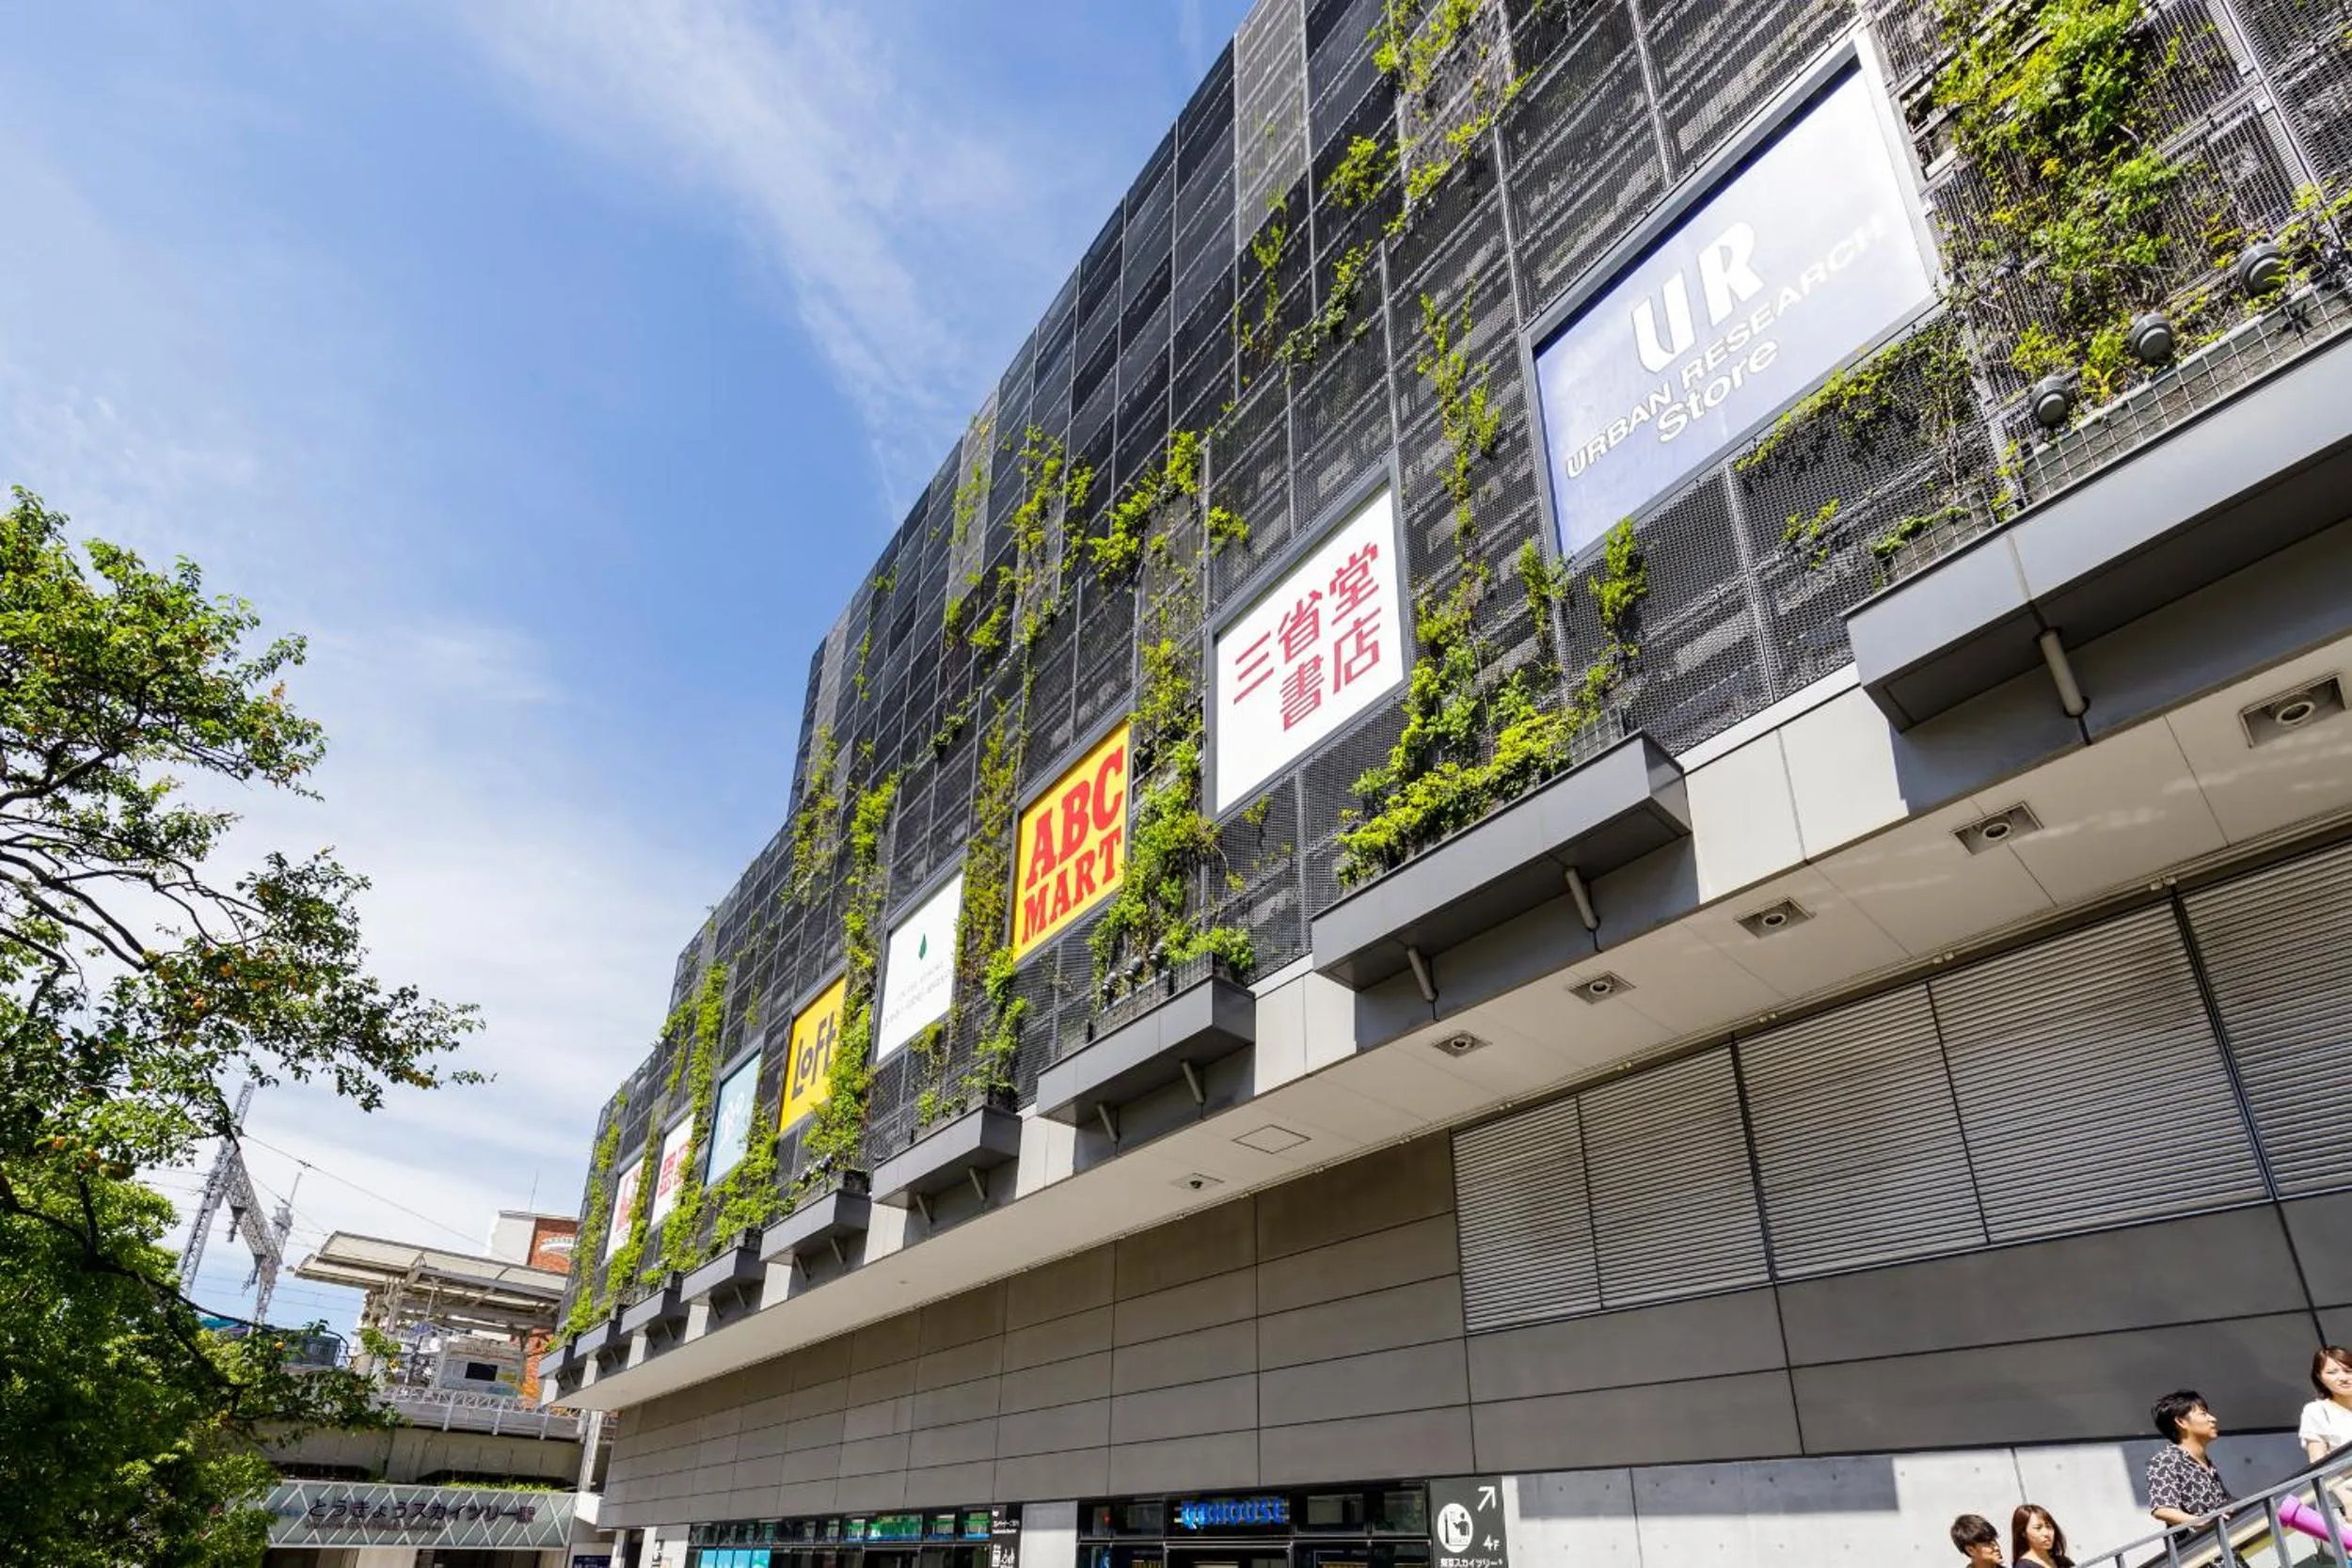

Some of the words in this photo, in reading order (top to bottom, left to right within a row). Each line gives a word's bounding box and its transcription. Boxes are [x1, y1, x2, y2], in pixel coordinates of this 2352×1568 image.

[1565, 382, 1674, 478] URBAN
[1681, 213, 1885, 386] RESEARCH
[1631, 222, 1762, 372] UR
[1656, 340, 1780, 444] Store
[1233, 542, 1379, 705] 三省堂
[1279, 607, 1381, 732] 書店
[1022, 826, 1121, 945] MART
[1025, 745, 1123, 892] ABC
[1483, 1534, 1501, 1551] 4F
